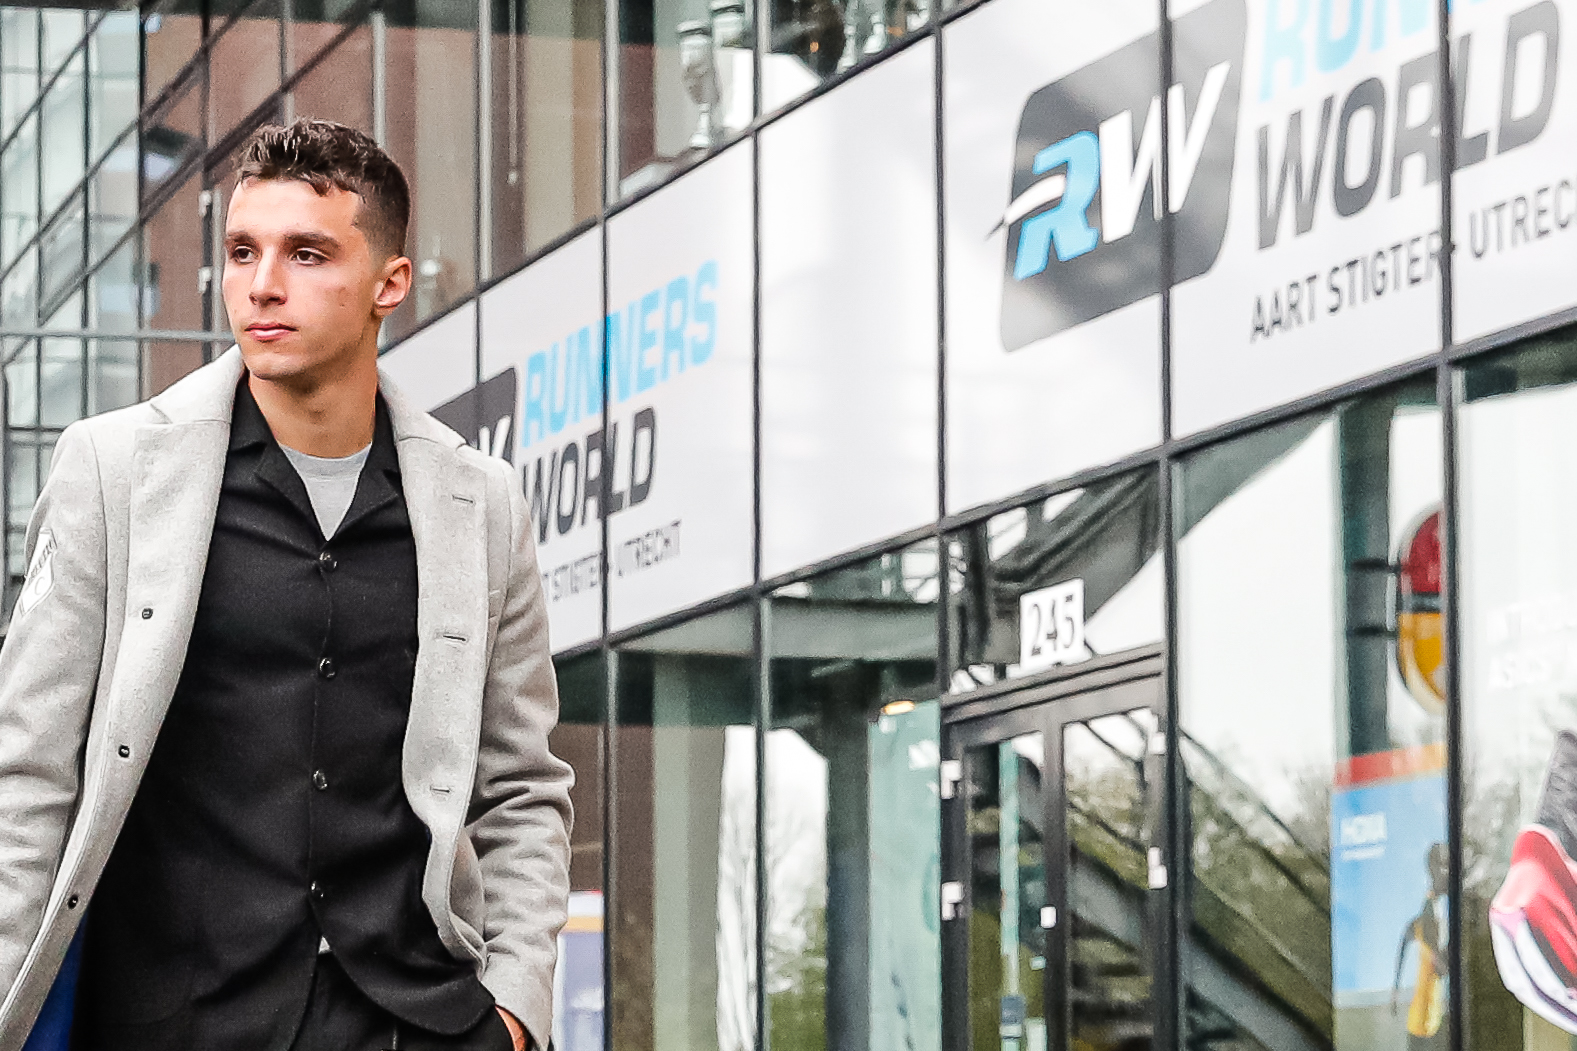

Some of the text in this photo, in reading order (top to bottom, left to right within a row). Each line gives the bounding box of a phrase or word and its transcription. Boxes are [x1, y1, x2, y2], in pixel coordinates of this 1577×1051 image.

[1006, 61, 1231, 282] RW
[1255, 0, 1560, 250] WORLD
[1250, 176, 1577, 343] AART STIGTER UTREC
[522, 259, 718, 448] RUNNERS
[522, 407, 655, 545] WORLD
[1028, 593, 1075, 657] 245
